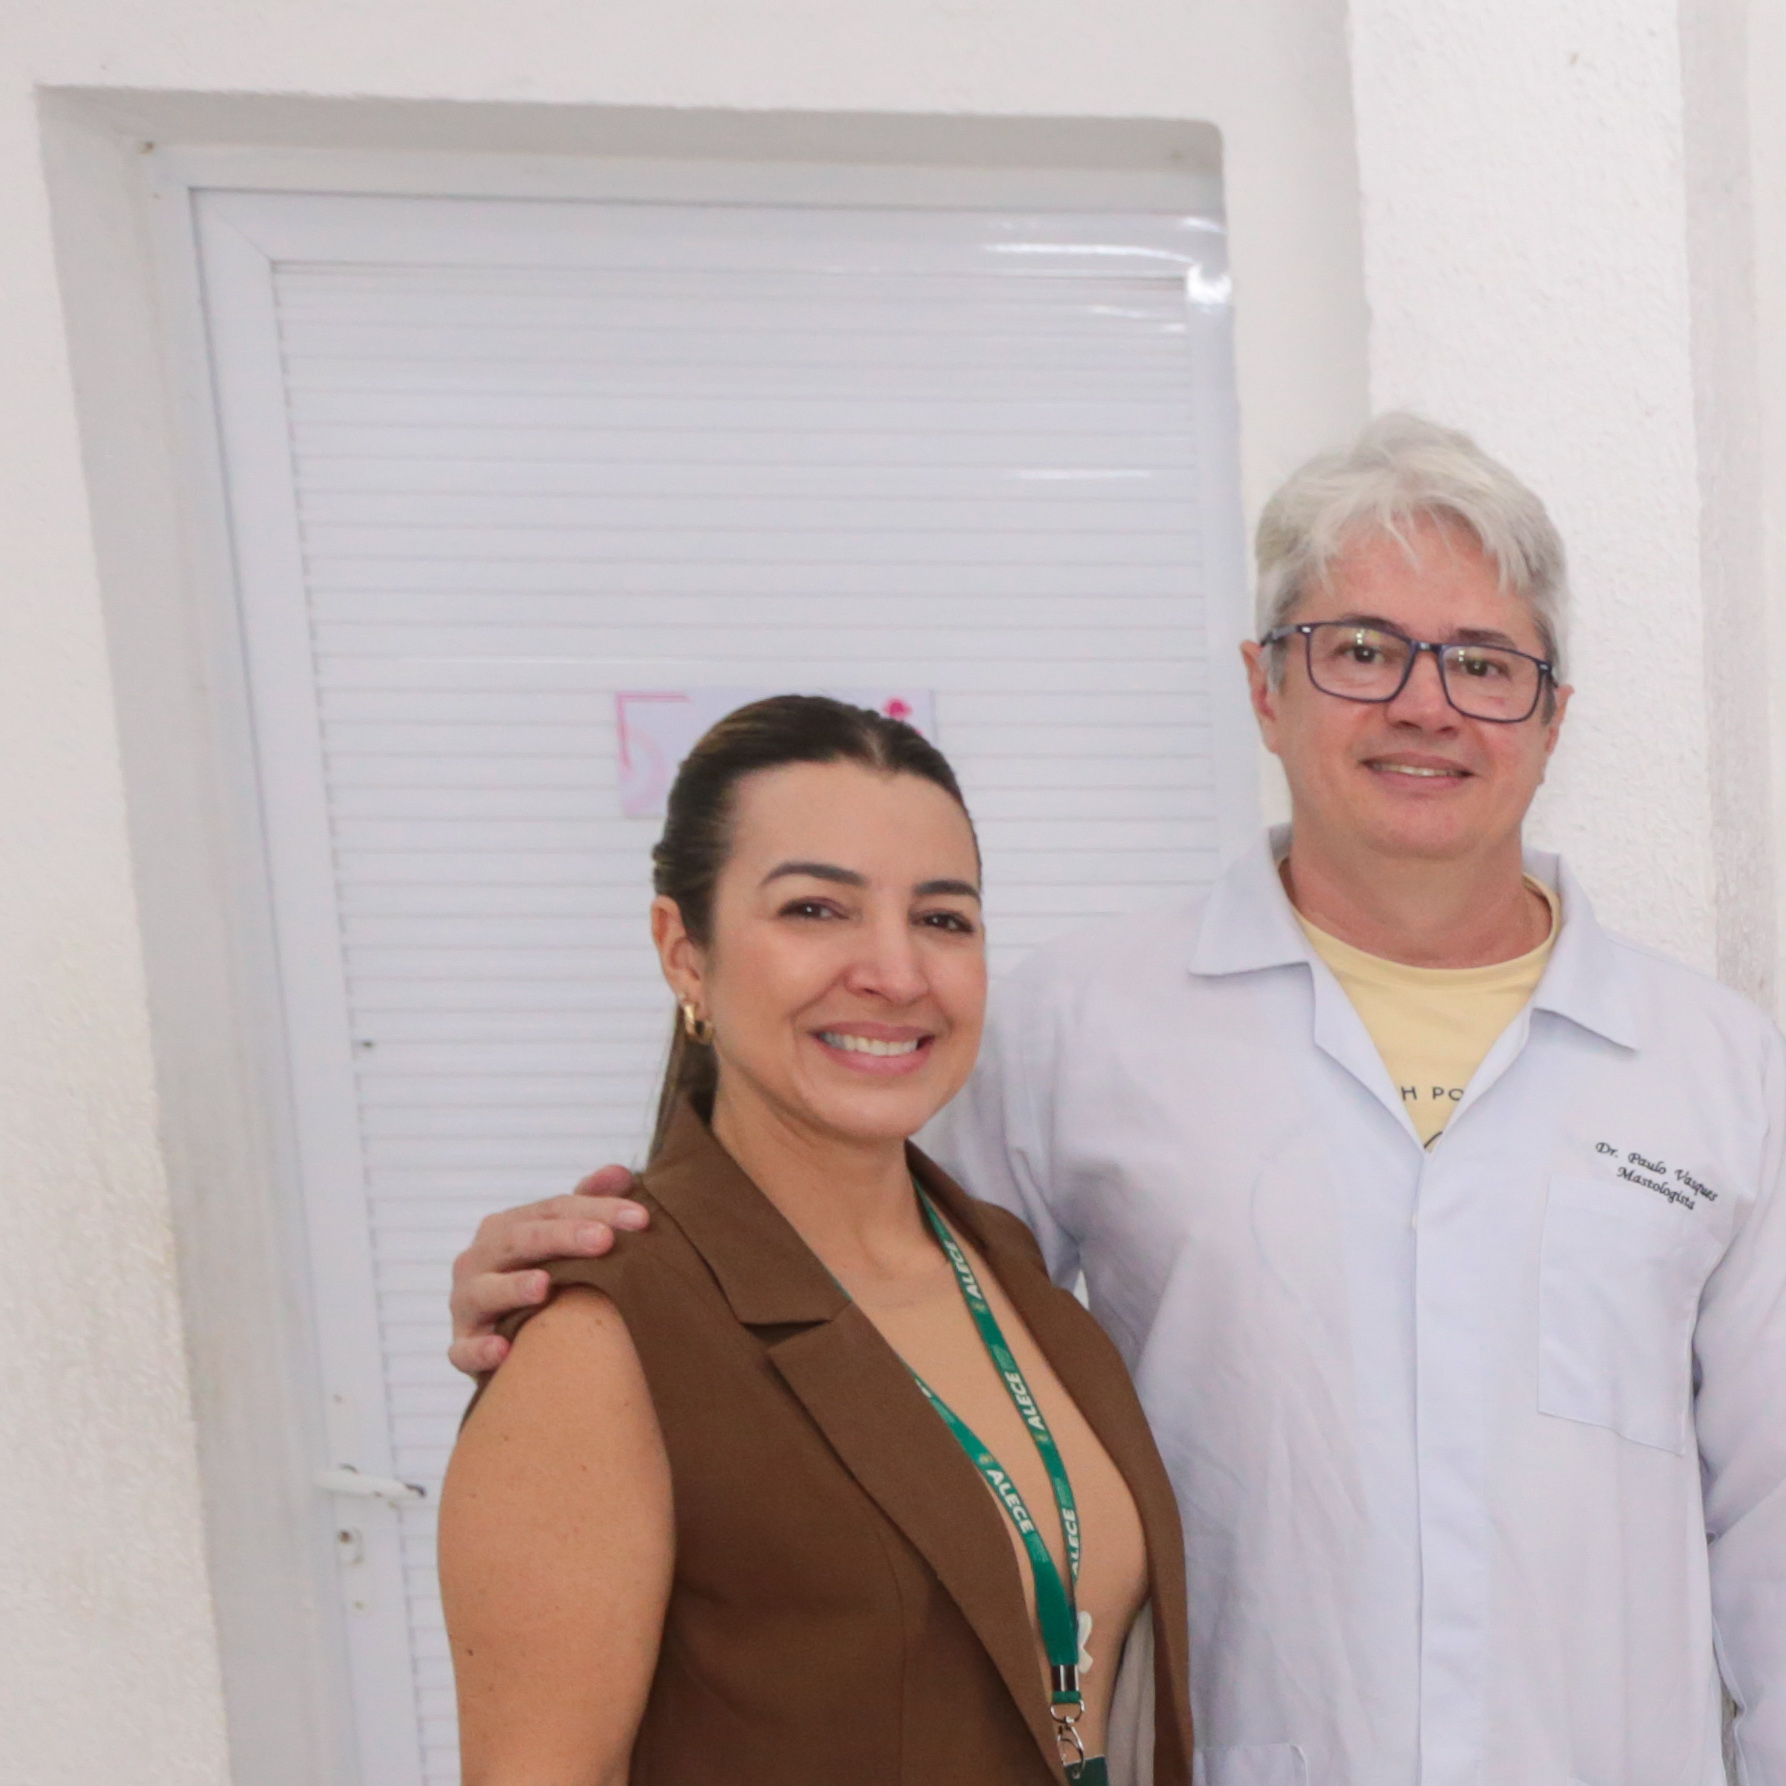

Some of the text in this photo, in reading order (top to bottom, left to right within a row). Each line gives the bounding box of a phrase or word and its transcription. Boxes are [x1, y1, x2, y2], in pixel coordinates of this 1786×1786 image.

[1595, 1141, 1719, 1202] Dr. Paulo Vasques
[1004, 1371, 1046, 1431] ALECE
[985, 1468, 1036, 1535] ALECE
